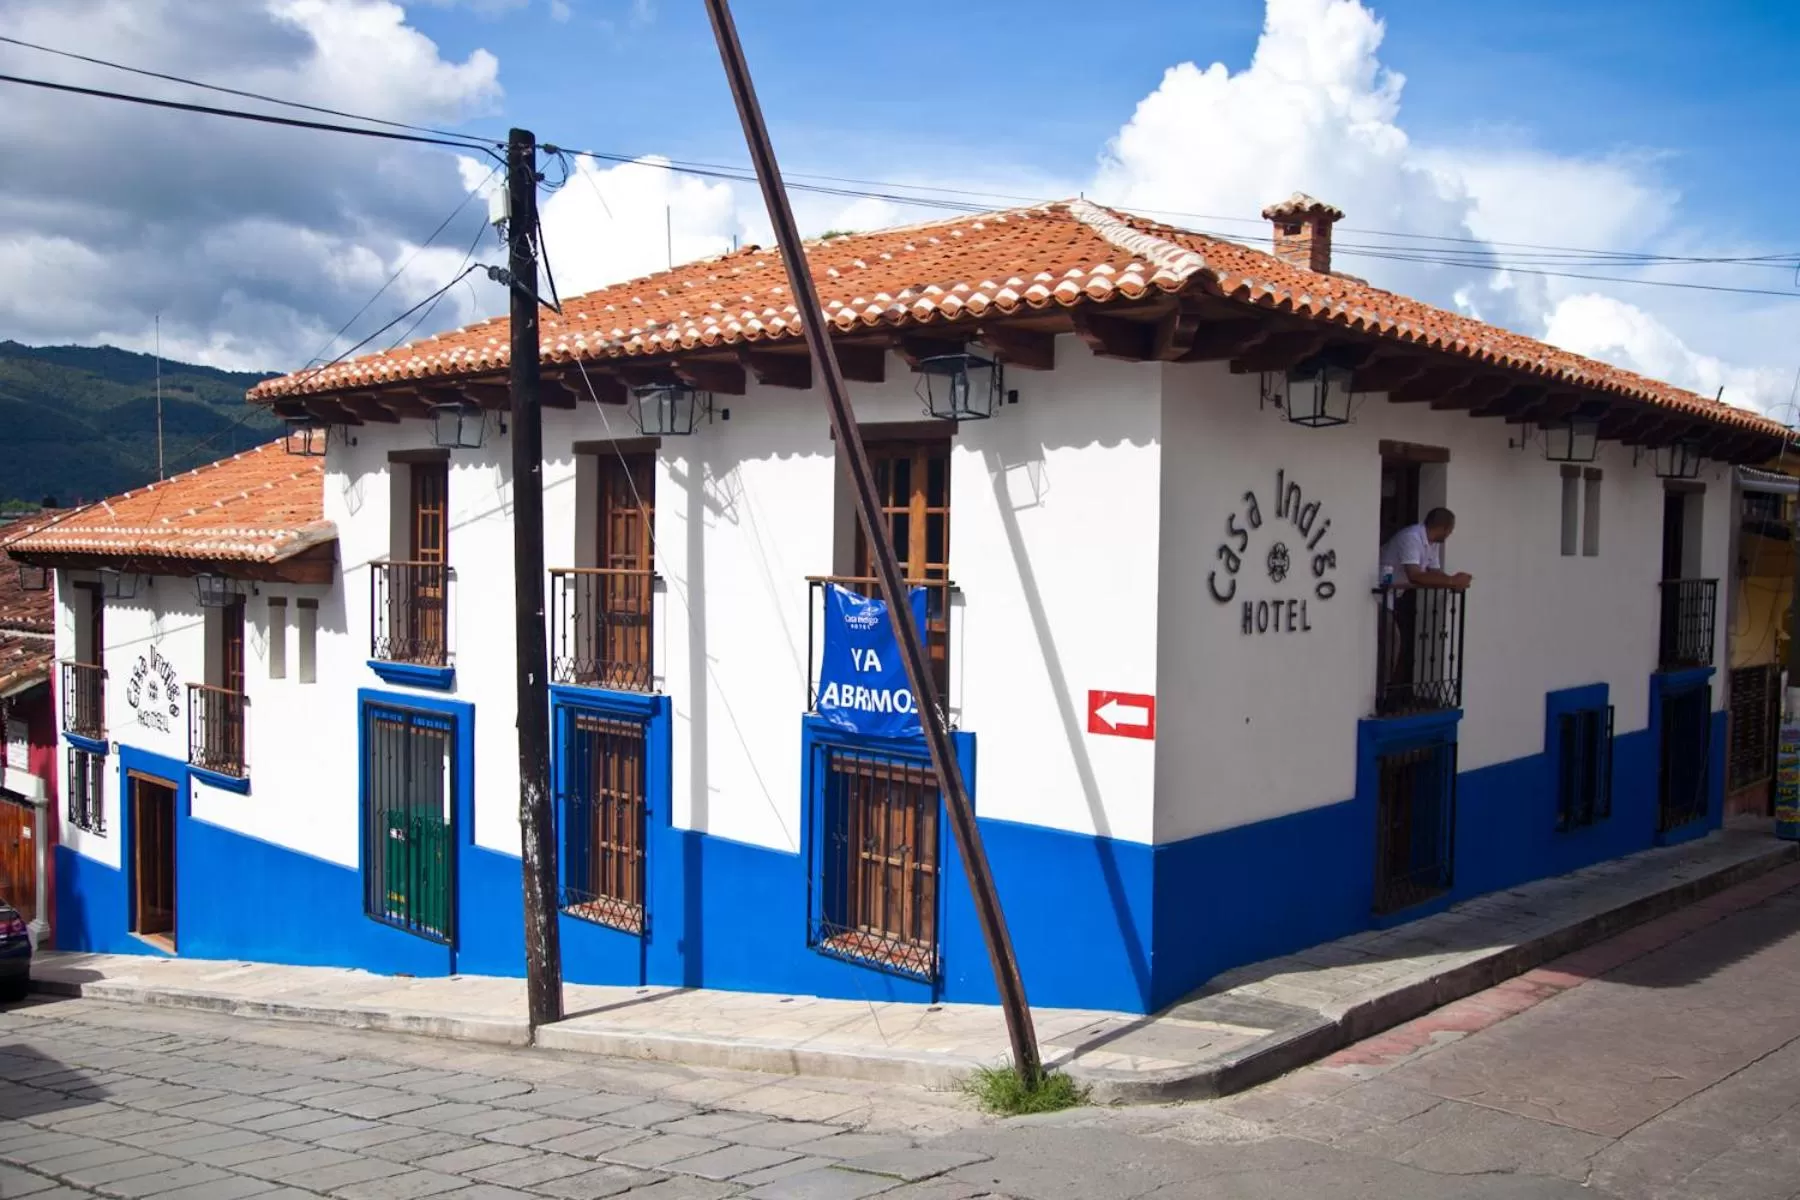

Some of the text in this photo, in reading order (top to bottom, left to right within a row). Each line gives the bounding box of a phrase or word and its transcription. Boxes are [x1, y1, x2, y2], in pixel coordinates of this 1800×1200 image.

[1207, 468, 1337, 604] Casa Indigo
[1241, 599, 1312, 635] HOTEL
[850, 647, 883, 672] YA
[138, 708, 170, 734] HOTEL
